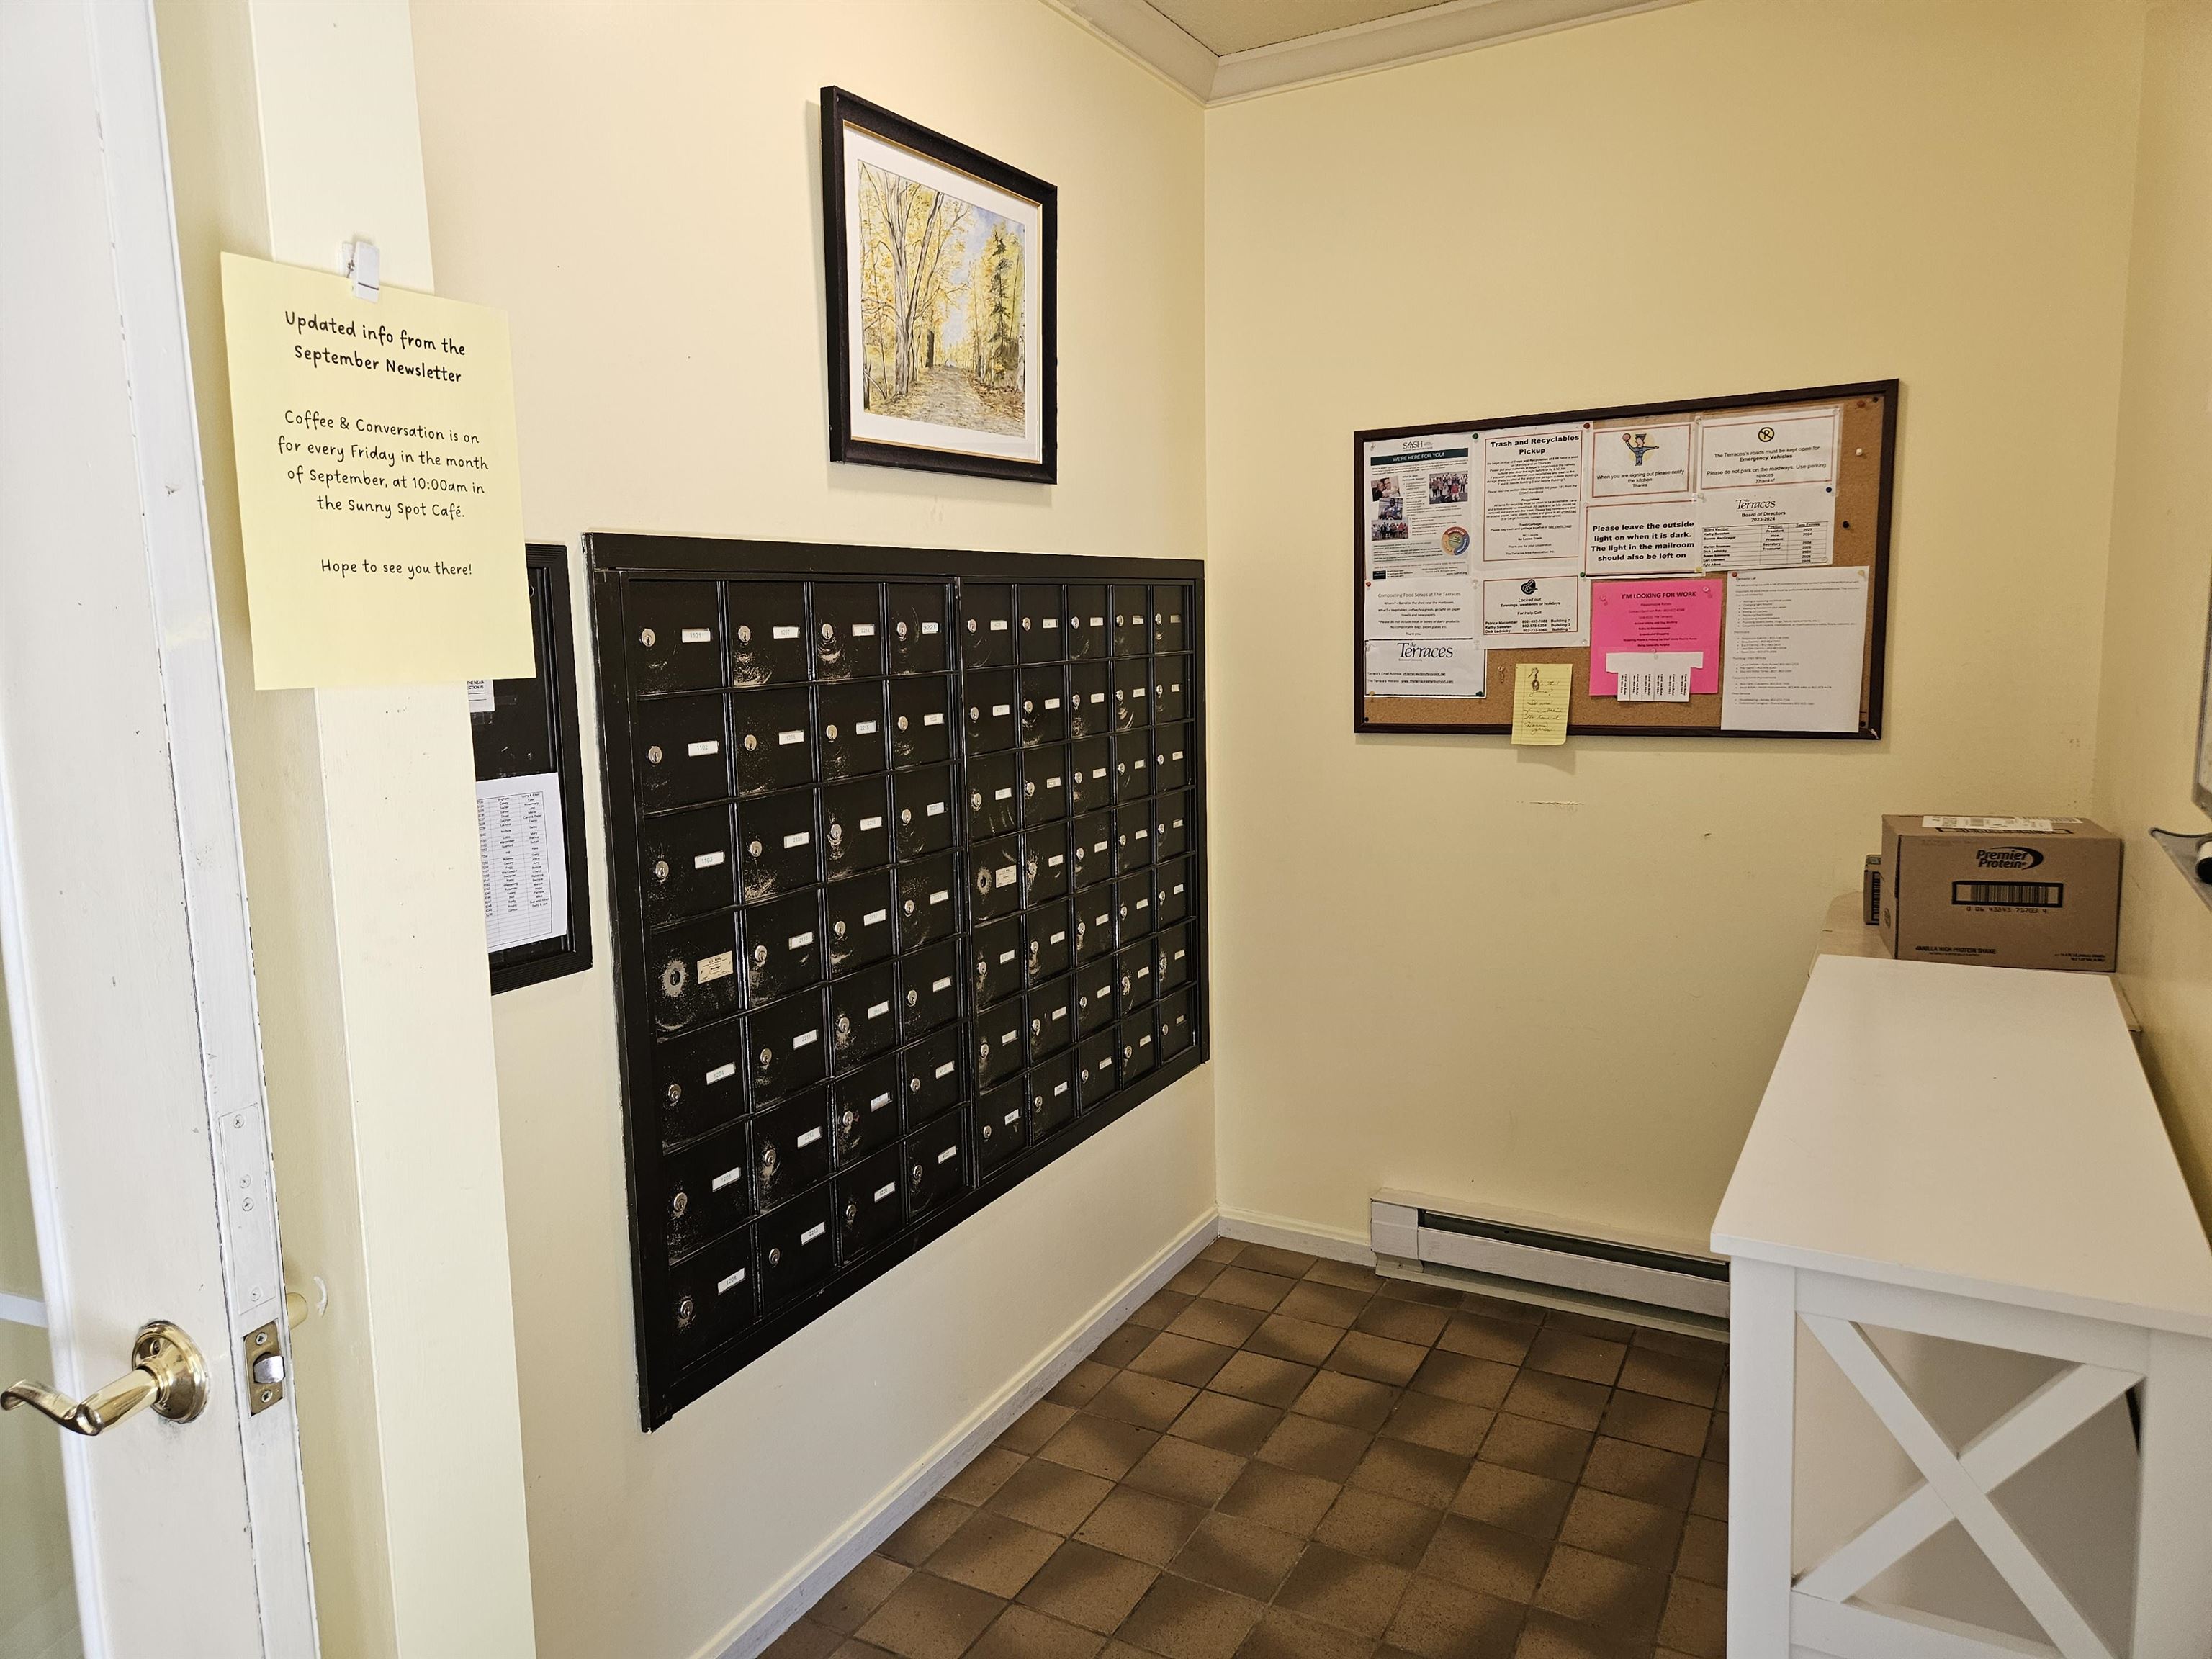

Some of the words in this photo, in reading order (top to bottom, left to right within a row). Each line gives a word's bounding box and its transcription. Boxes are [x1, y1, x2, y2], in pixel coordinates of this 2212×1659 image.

[285, 311, 356, 337] Updated
[363, 325, 393, 346] info
[400, 330, 436, 350] from
[441, 338, 465, 355] the
[295, 345, 379, 369] September
[386, 359, 461, 382] Newsletter
[285, 410, 333, 430] Coffee
[340, 417, 349, 429] &
[356, 419, 444, 439] Conversation
[450, 430, 458, 441] is
[464, 435, 479, 444] on
[1531, 435, 1579, 444] Recyclables
[278, 436, 301, 454] for
[308, 444, 344, 462] every
[351, 444, 395, 467] Friday
[401, 451, 414, 462] in
[418, 451, 441, 465] the
[446, 457, 488, 469] month
[288, 465, 303, 484] of
[310, 469, 387, 488] September,
[393, 475, 407, 488] at
[413, 477, 467, 492] 10:00am
[472, 482, 485, 493] in
[317, 495, 342, 510] the
[349, 500, 391, 519] Sunny
[397, 503, 426, 520] Spot
[432, 503, 464, 520] Café.
[1736, 499, 1776, 510] Terraces
[322, 559, 356, 578] Hope
[362, 559, 377, 572] to
[383, 565, 402, 573] see
[408, 565, 430, 580] you
[434, 562, 472, 575] there!
[1398, 643, 1453, 658] Terraces
[1976, 849, 2028, 861] Premier
[1978, 858, 2023, 869] Protein
